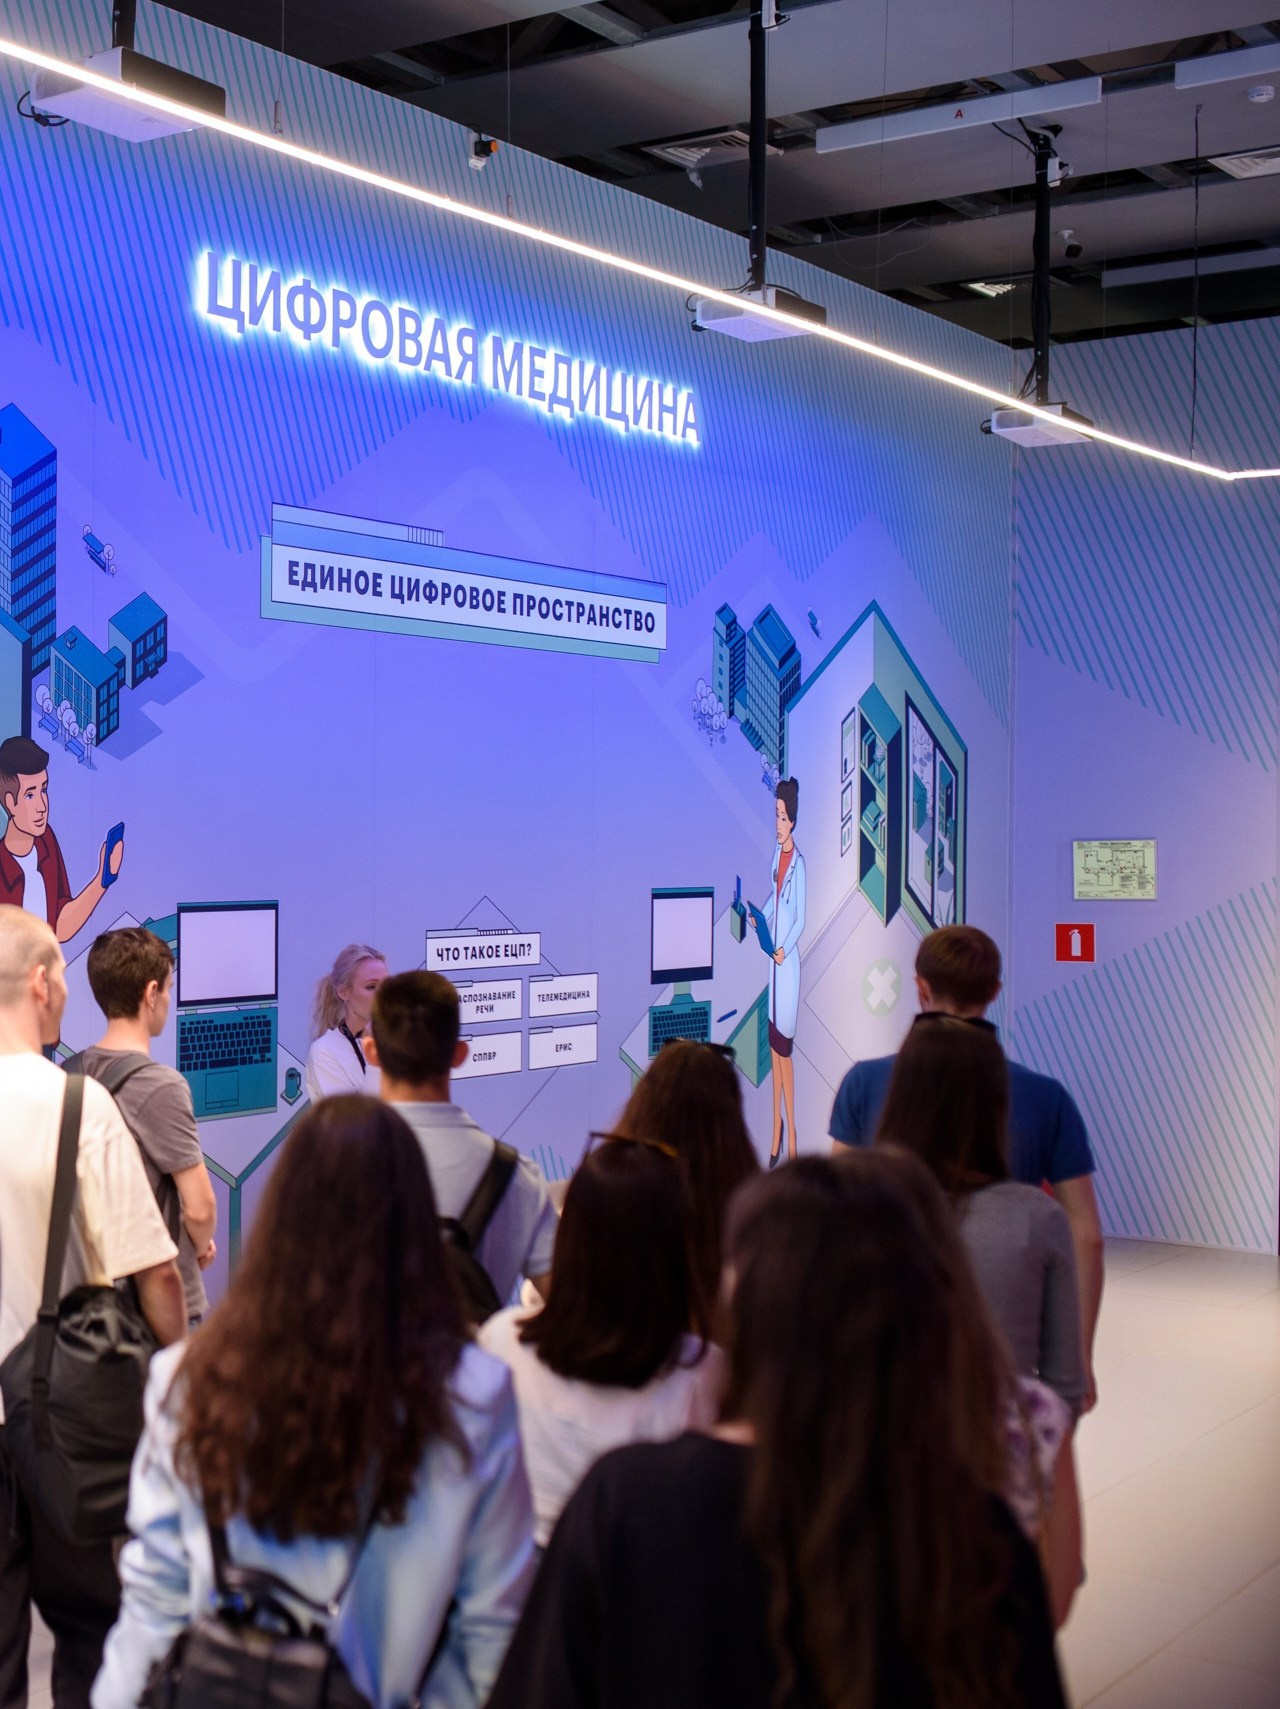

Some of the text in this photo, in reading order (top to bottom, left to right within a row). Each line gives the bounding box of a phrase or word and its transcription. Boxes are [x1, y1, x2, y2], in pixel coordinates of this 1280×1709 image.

[204, 250, 702, 443] ЦИФРОВАЯ МЕДИЦИНА
[287, 560, 656, 635] ЕДИНОЕ ЦИФРОВОЕ ПРОСТРАНСТВО
[436, 943, 532, 962] ЧТО ТАКОЕ ЕЦП?
[459, 990, 516, 1004] АСПОЗНАВАНИЕ
[537, 990, 591, 1003] ТЕЛЕМЕДИЦИНА
[475, 1004, 495, 1014] РЕЧИ
[555, 1042, 573, 1053] ЕРИС
[472, 1051, 497, 1062] СППВР
